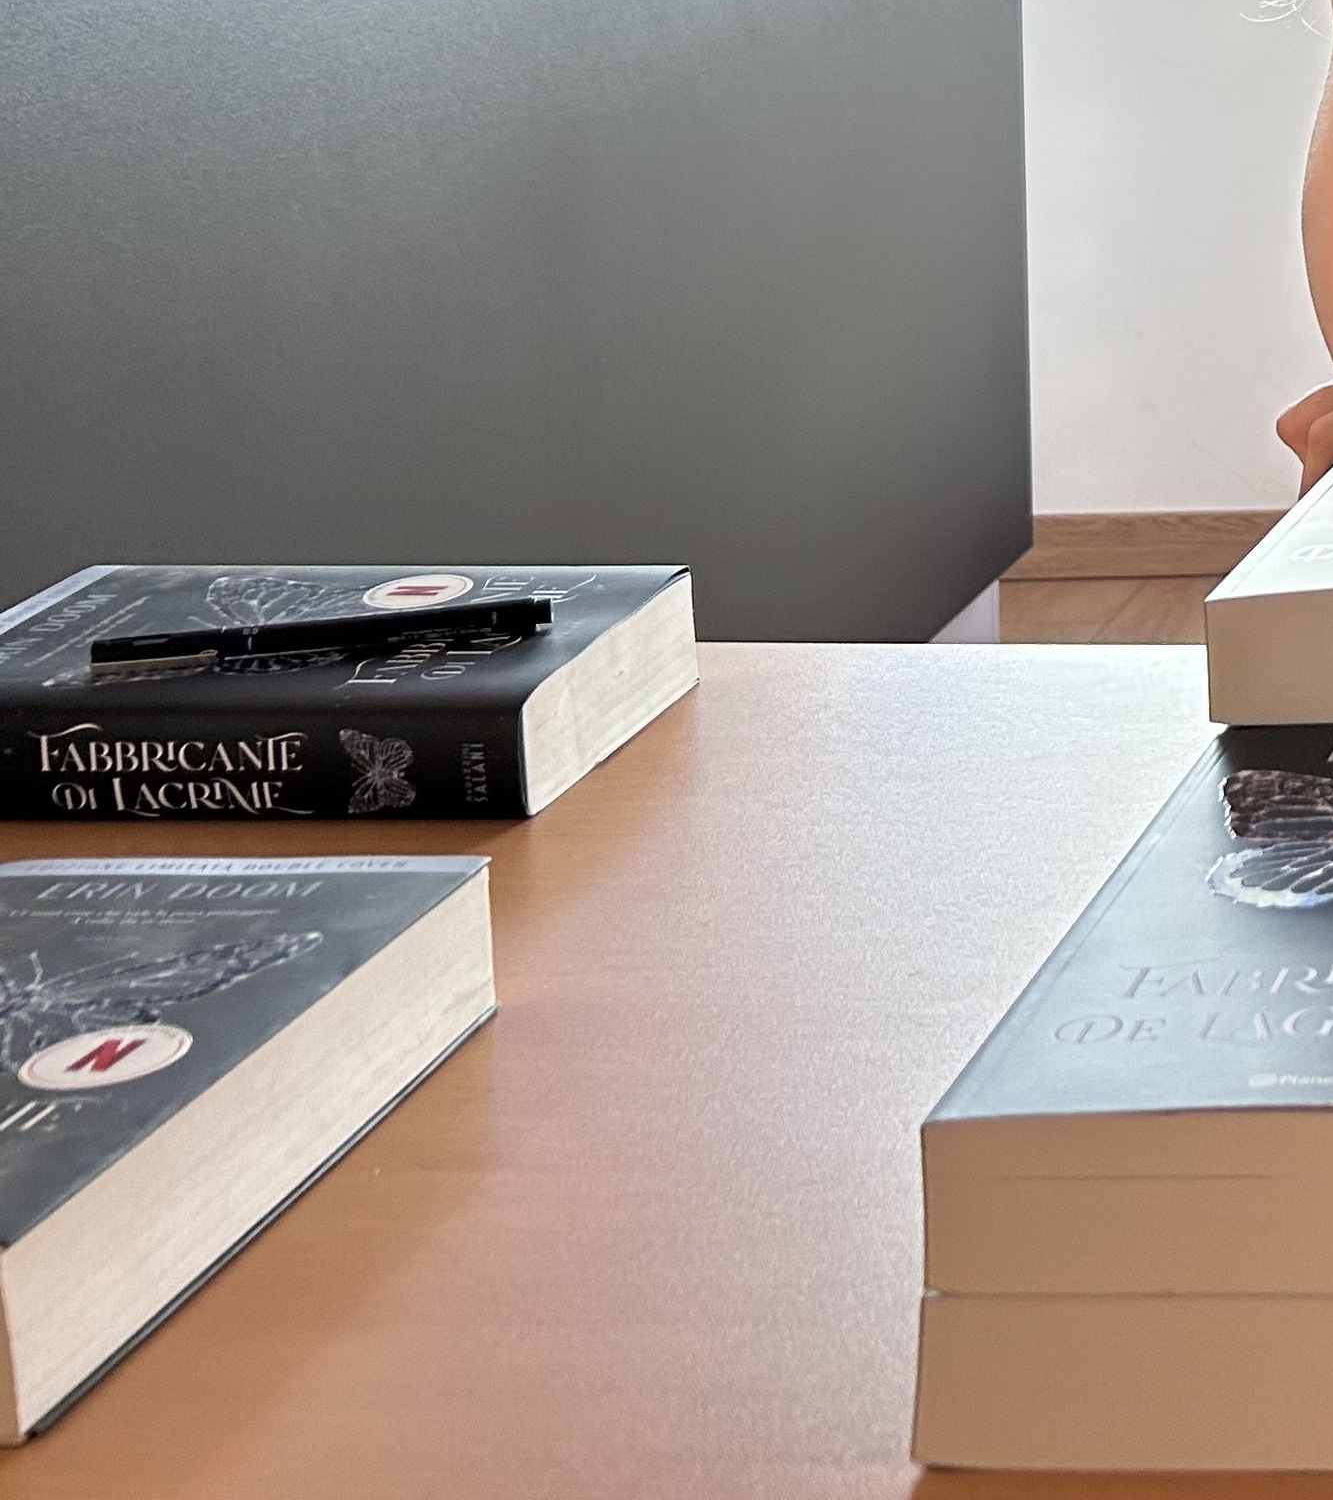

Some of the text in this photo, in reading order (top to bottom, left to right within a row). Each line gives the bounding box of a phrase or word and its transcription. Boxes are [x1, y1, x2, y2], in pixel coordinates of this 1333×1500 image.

[27, 722, 309, 773] FABBRICANTE
[469, 743, 489, 802] SALANI
[51, 776, 316, 818] DI LACRIME
[37, 881, 325, 900] ERIN DOOM
[1053, 1013, 1169, 1044] DE
